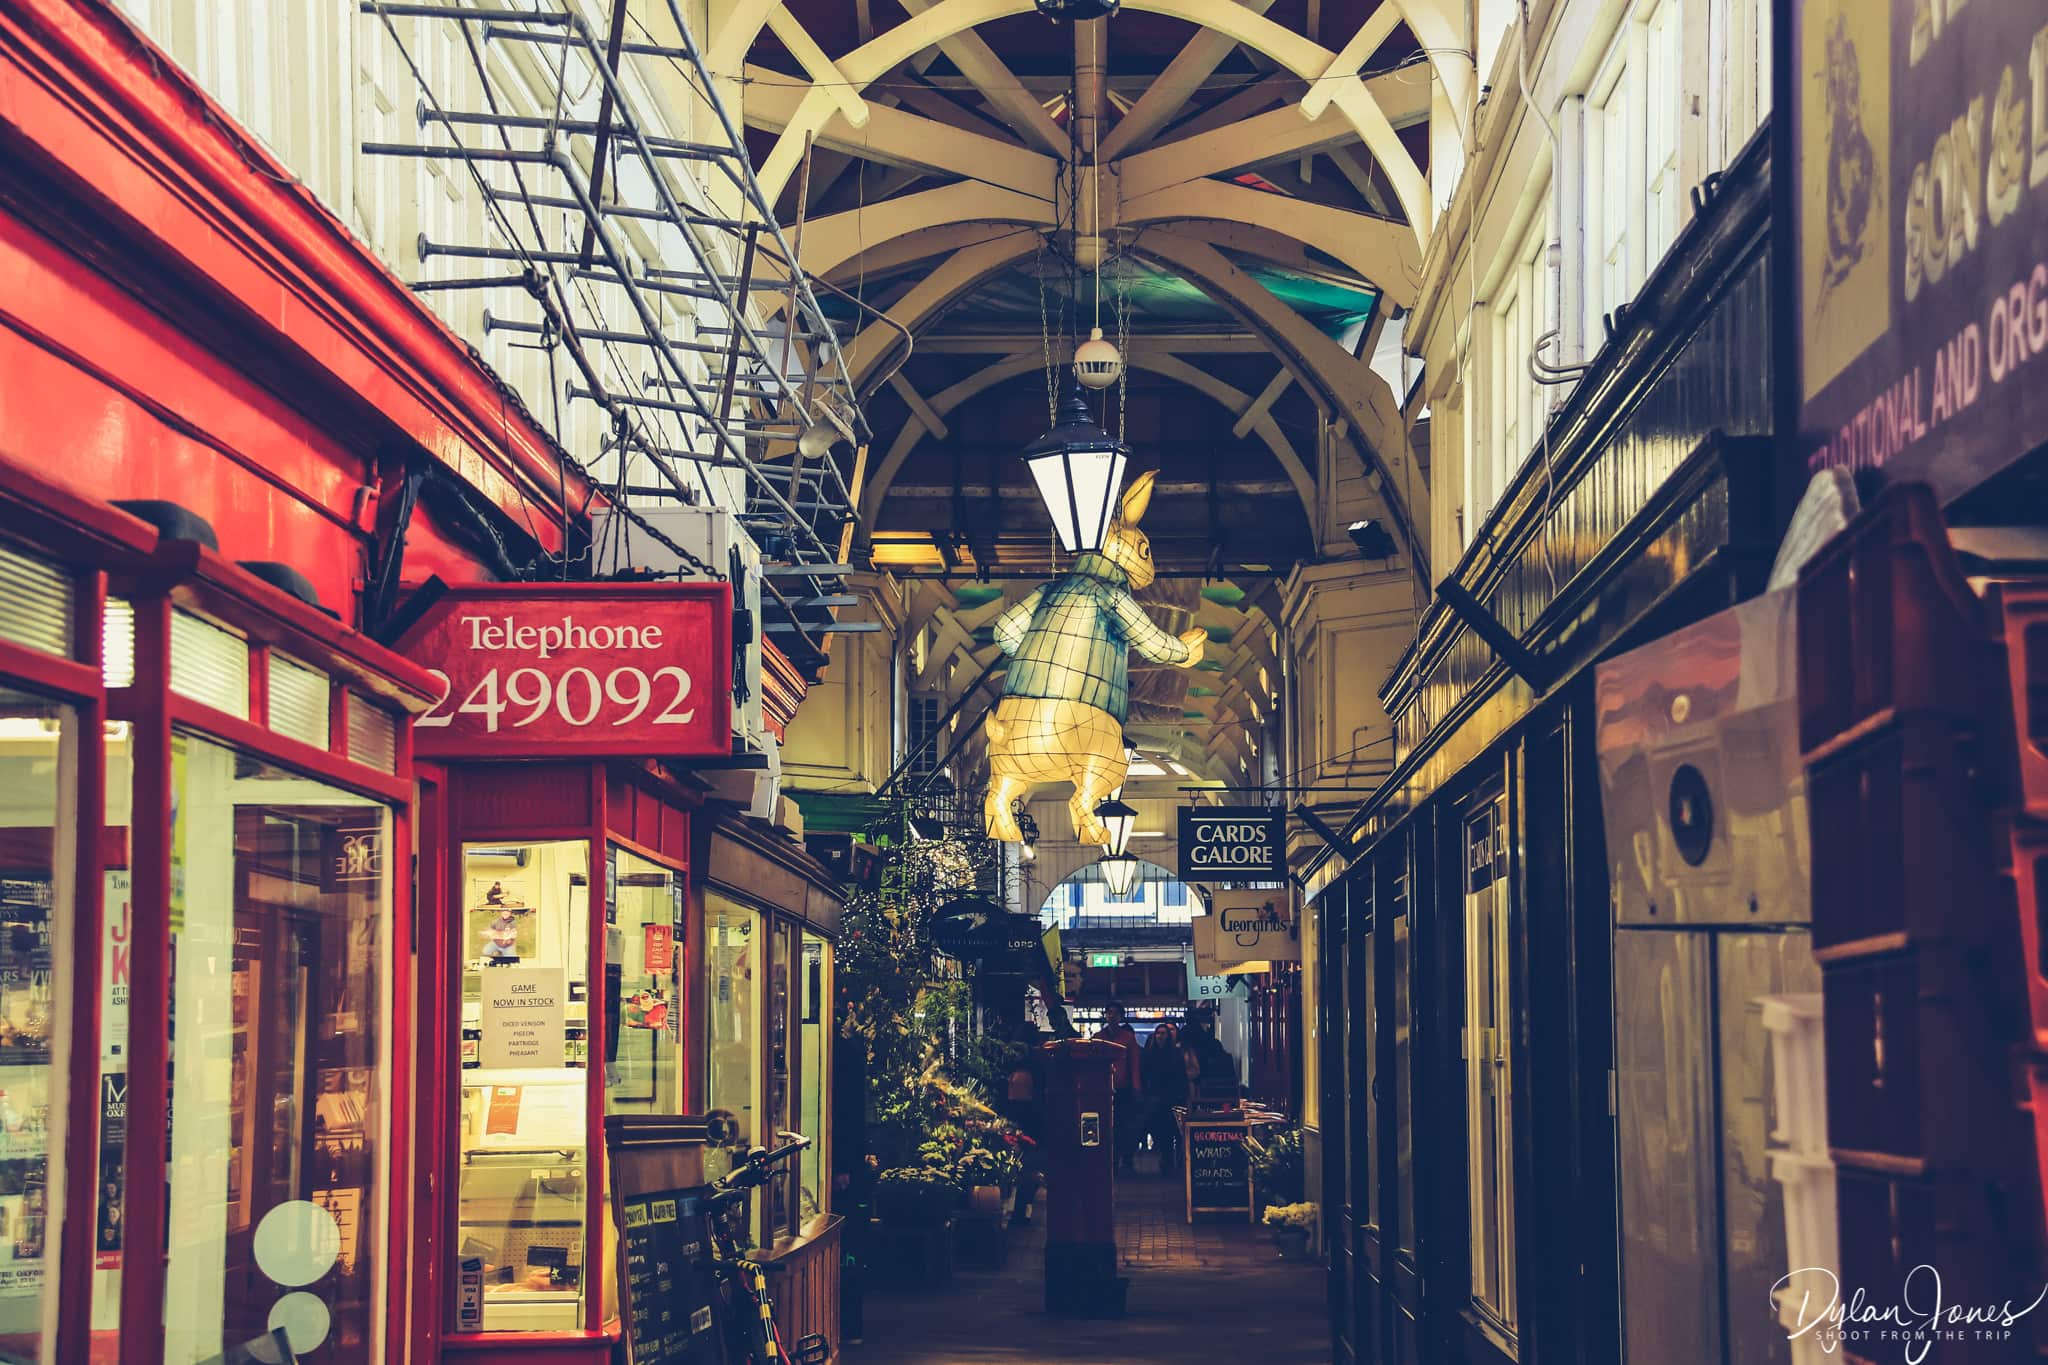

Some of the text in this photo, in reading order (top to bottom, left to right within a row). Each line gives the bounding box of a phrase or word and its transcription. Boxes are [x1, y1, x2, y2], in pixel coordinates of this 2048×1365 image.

[1905, 94, 1983, 302] SON
[1986, 65, 2025, 228] &
[1931, 322, 1980, 428] AND
[461, 615, 663, 659] Telephone
[412, 666, 696, 733] 249092
[1196, 824, 1266, 843] CARDS
[1190, 845, 1273, 864] GALORE
[511, 984, 537, 993] GAME
[1200, 985, 1233, 995] BOX
[493, 999, 515, 1007] NOW
[528, 998, 555, 1006] STOCK
[1195, 1147, 1232, 1159] WRAPS
